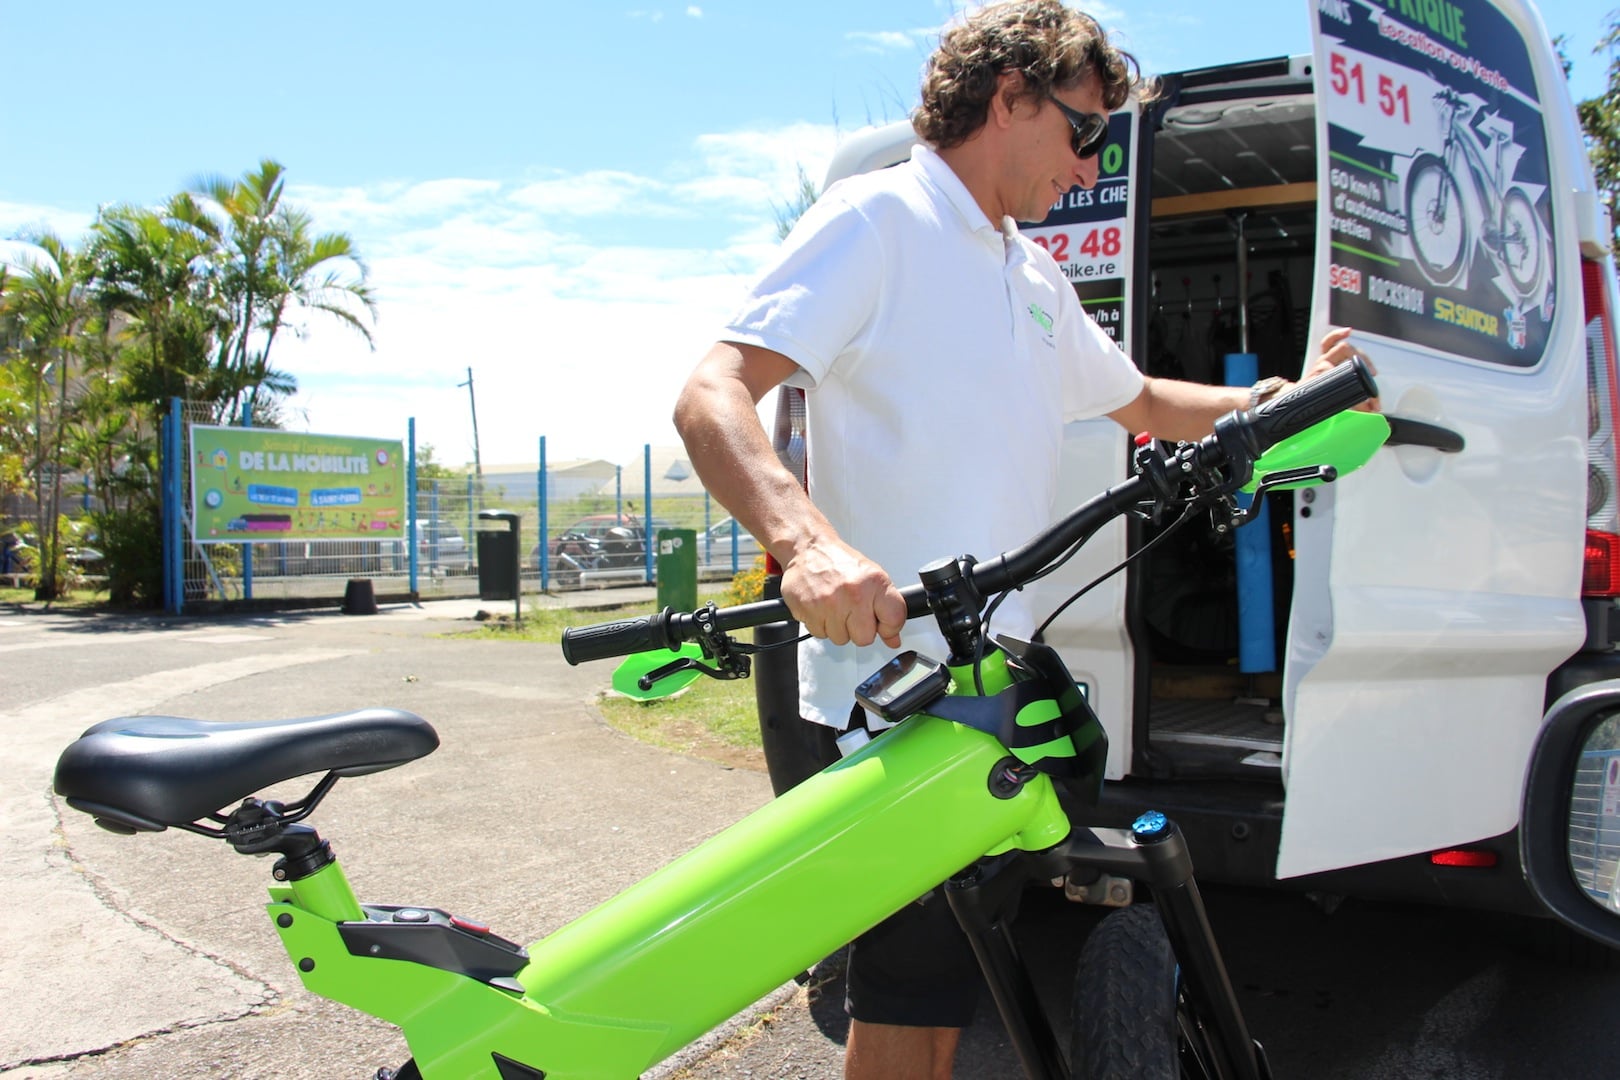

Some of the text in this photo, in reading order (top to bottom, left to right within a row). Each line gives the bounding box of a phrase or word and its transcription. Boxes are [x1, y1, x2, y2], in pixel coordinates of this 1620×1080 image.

[1378, 15, 1508, 92] Location ou Vente
[1331, 53, 1411, 125] 51 51
[1069, 189, 1095, 209] LES
[1100, 185, 1128, 204] CHE
[1350, 174, 1381, 202] km/h
[1080, 226, 1122, 259] 48
[1329, 263, 1362, 295] SCH
[239, 451, 265, 472] DE
[267, 452, 291, 472] LA
